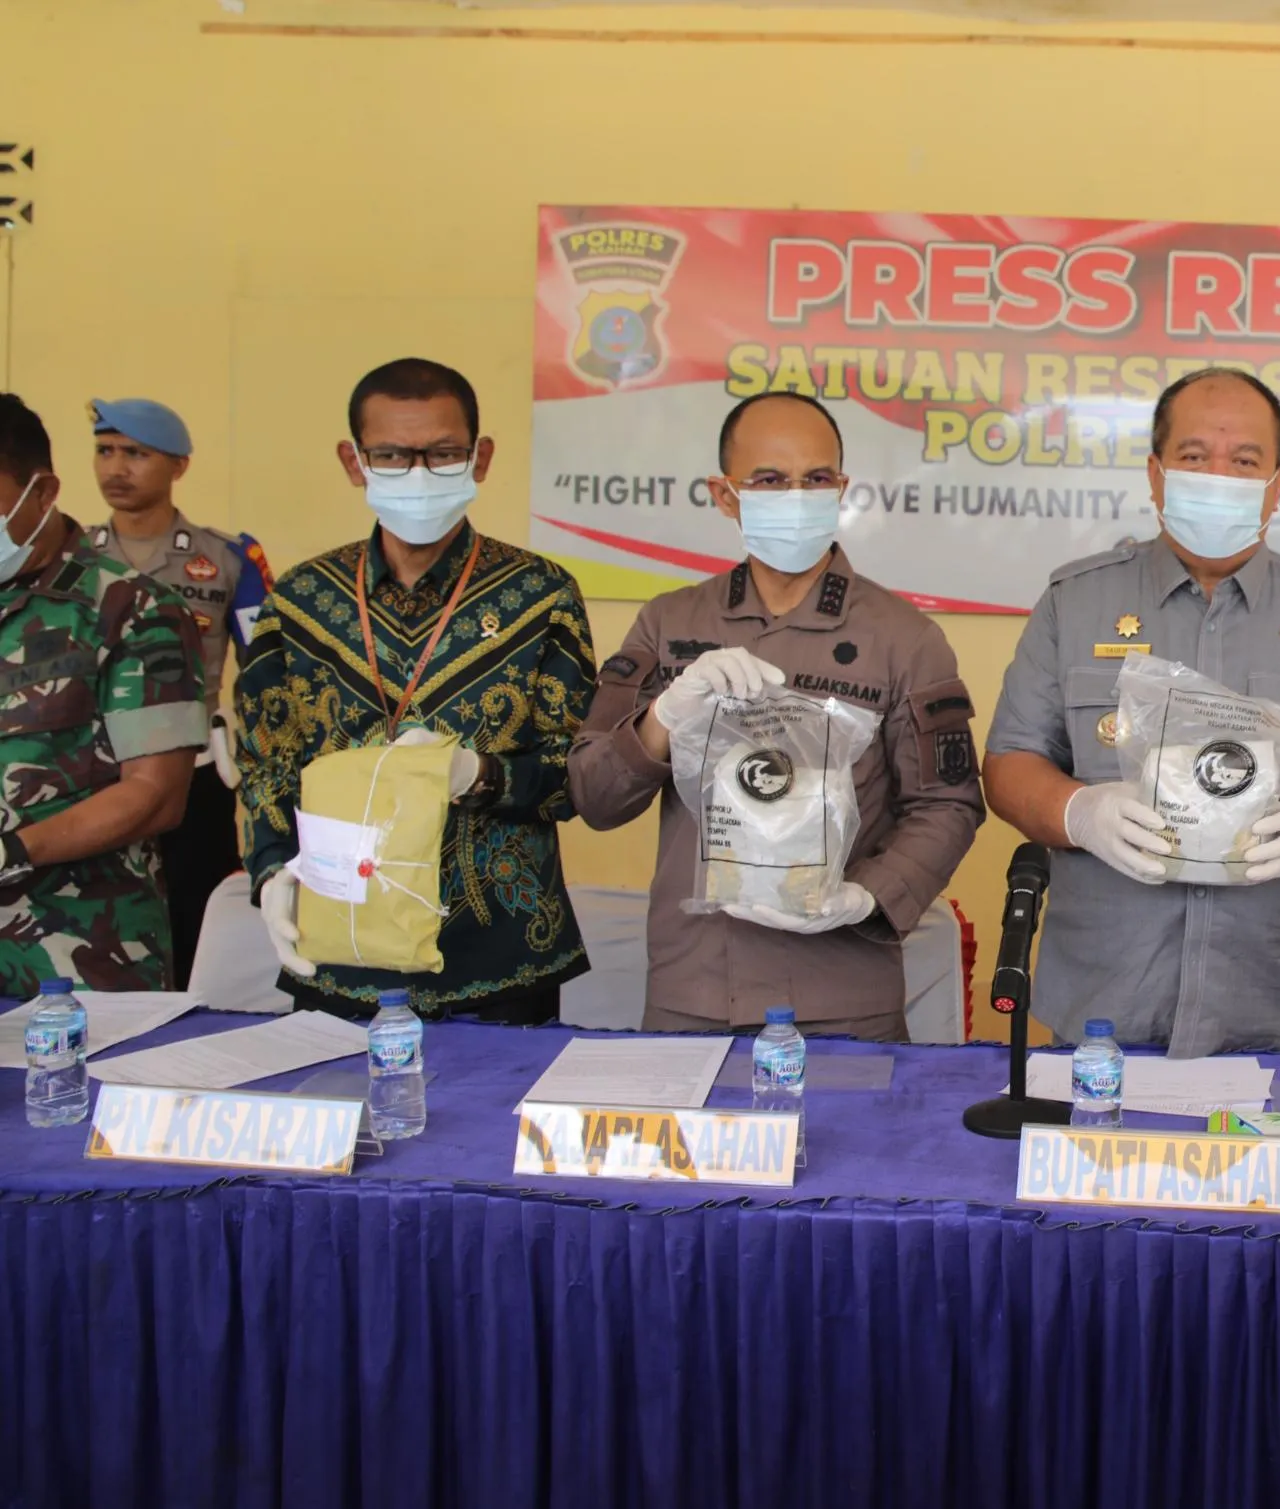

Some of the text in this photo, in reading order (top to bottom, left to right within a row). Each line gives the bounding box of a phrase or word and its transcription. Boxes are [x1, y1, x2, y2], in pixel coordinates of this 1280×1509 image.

[569, 229, 664, 252] POLRES
[768, 238, 1137, 333] PRESS
[726, 344, 1003, 402] SATUAN
[923, 410, 1154, 467] POLRE
[933, 485, 1129, 519] HUMANITY
[793, 673, 882, 704] KEJAKSAAN
[102, 1095, 356, 1166] PN KISARAN
[648, 1115, 786, 1173] ASAHAN
[1028, 1135, 1148, 1199] BUPATI
